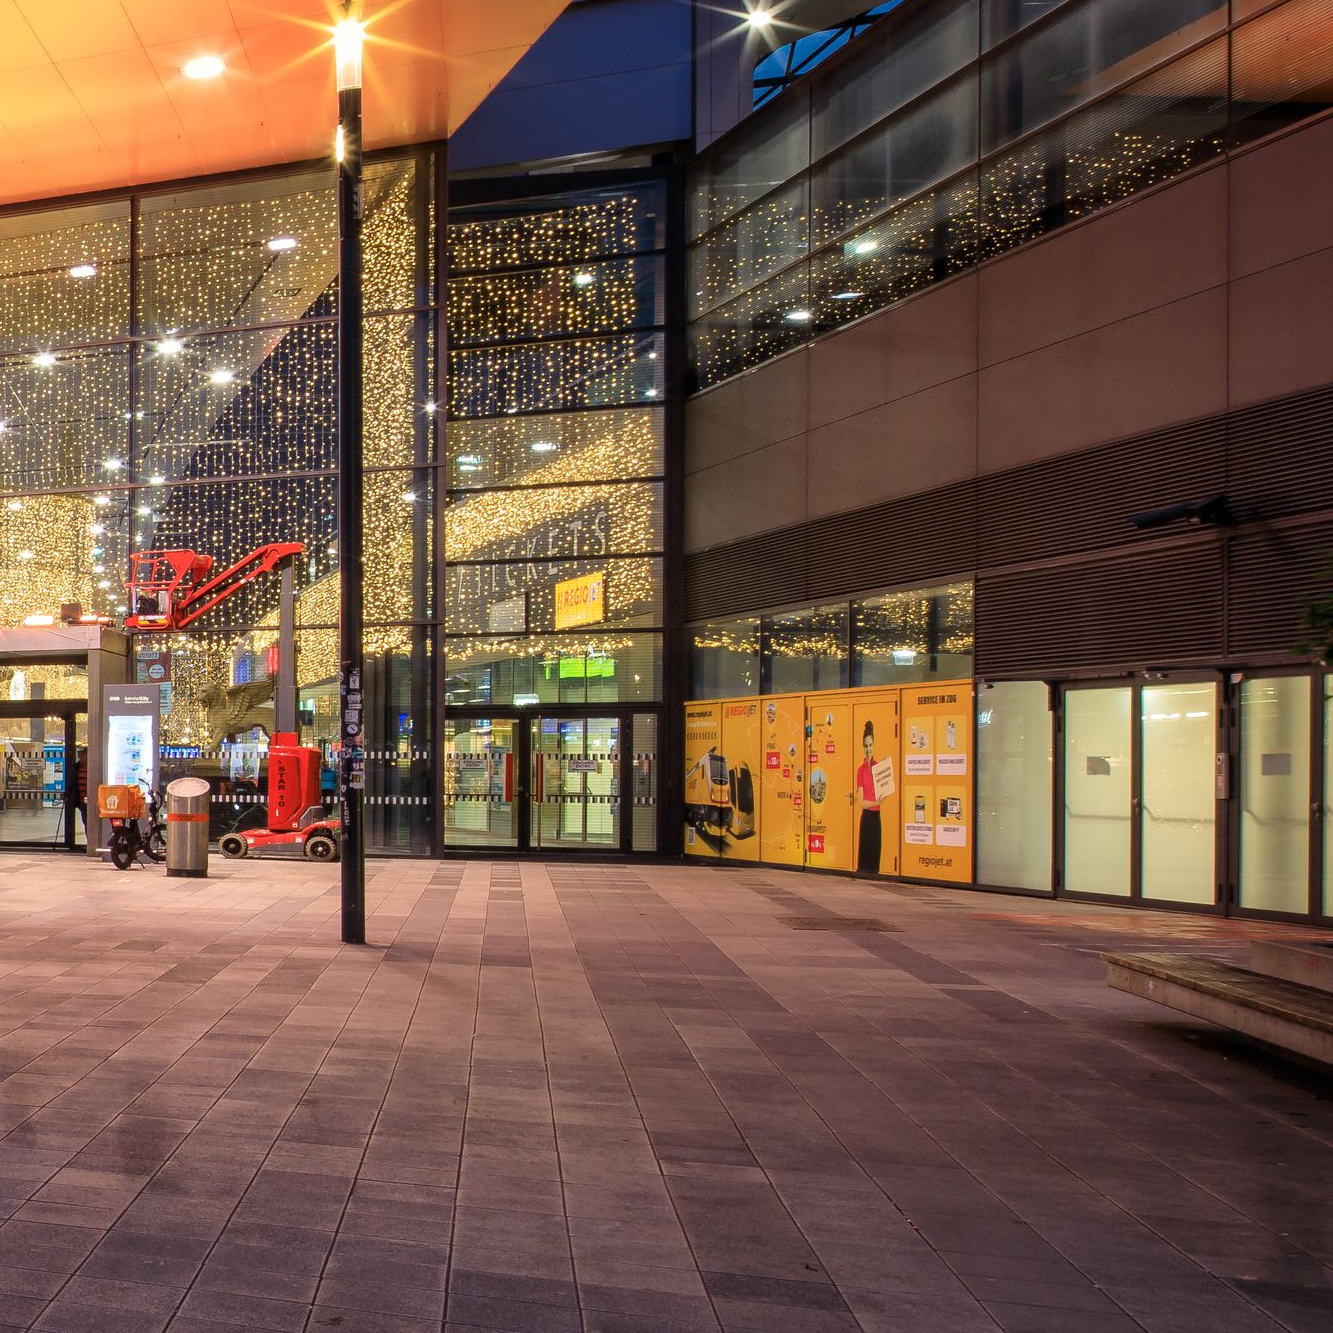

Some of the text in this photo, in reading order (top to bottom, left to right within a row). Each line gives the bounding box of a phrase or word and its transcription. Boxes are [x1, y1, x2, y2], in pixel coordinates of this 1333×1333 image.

[917, 696, 938, 705] SERVICE
[278, 795, 285, 807] 10
[918, 856, 953, 868] regiojet.at
